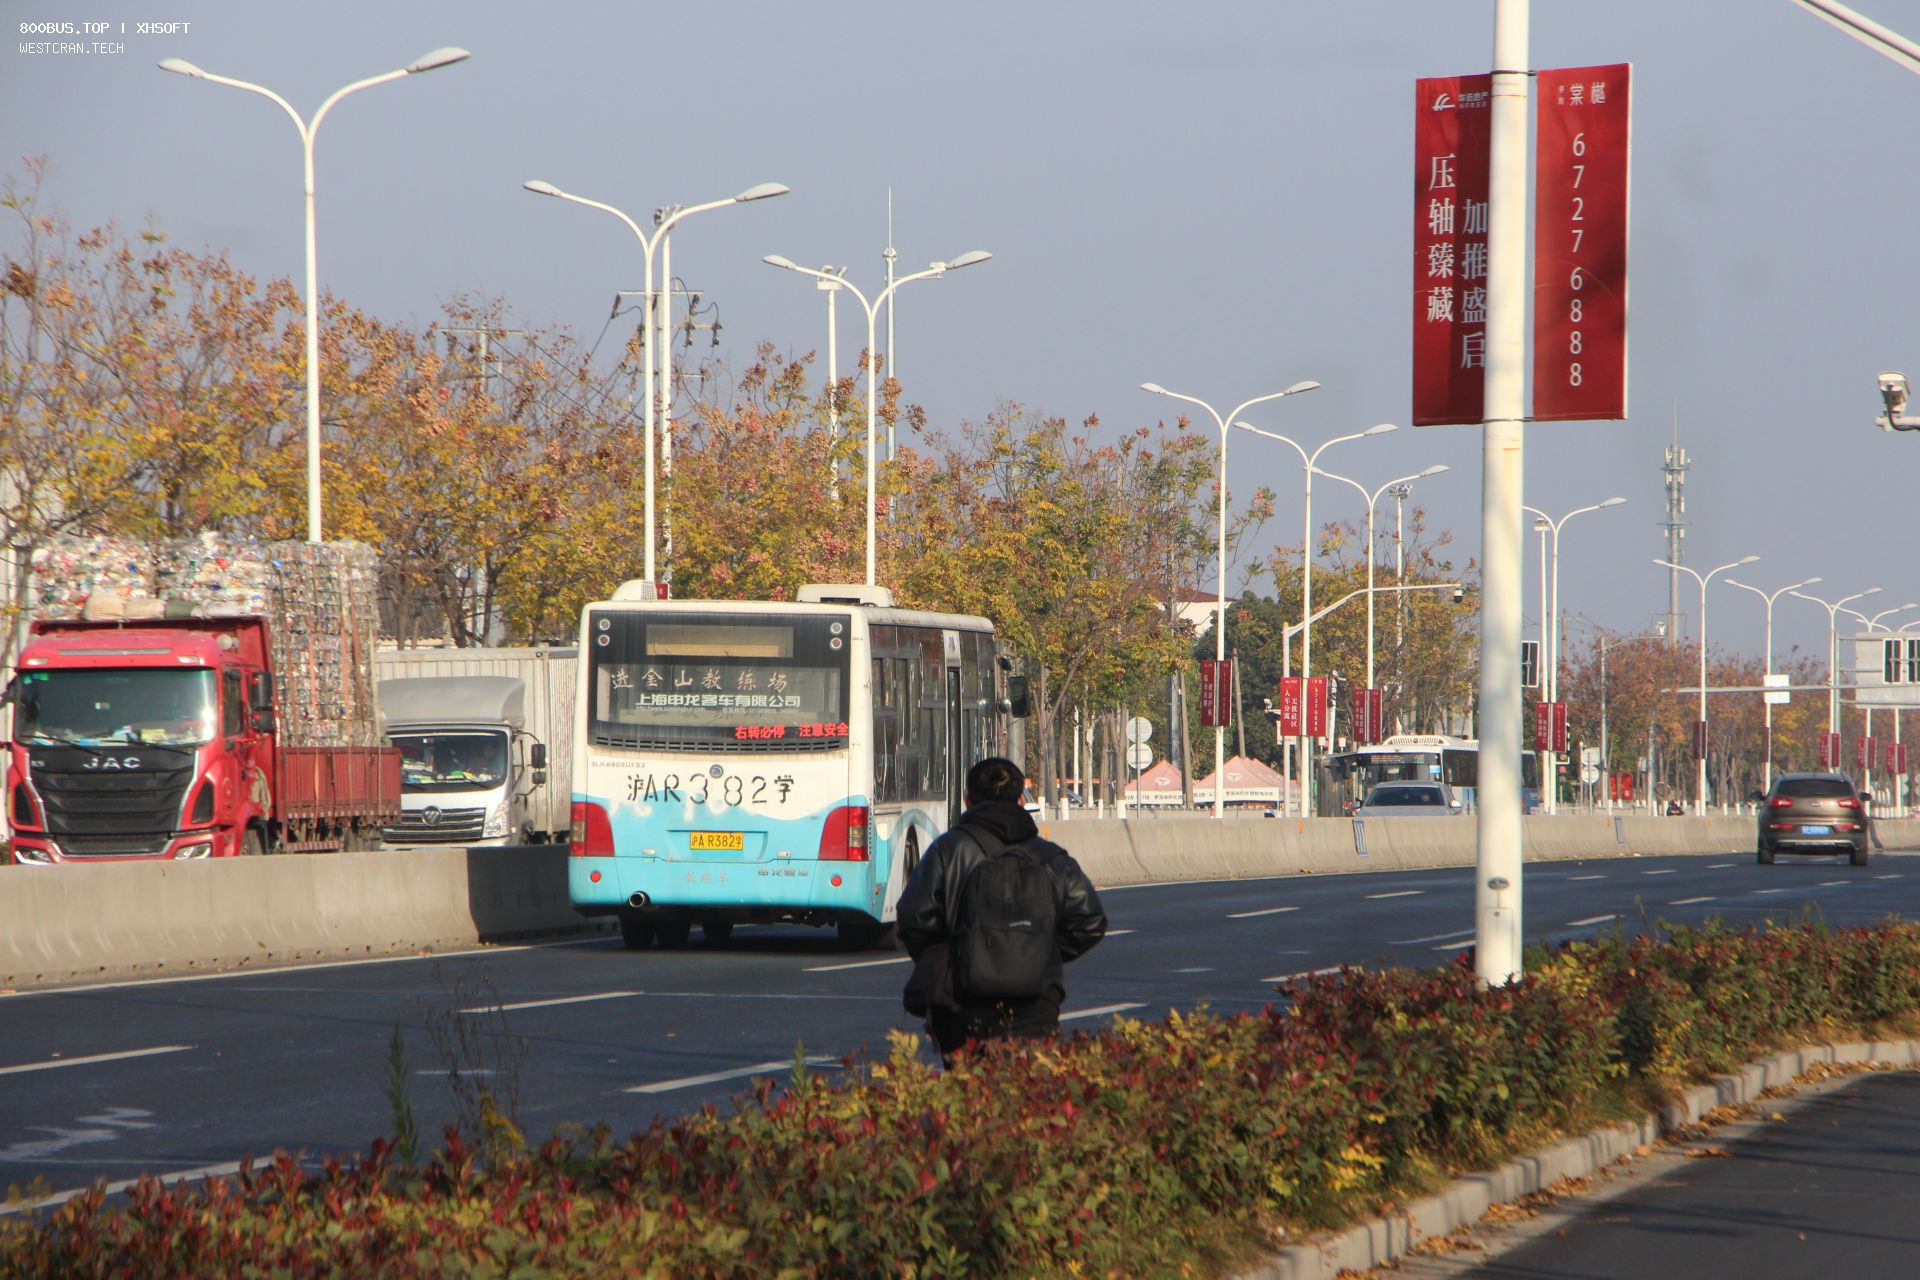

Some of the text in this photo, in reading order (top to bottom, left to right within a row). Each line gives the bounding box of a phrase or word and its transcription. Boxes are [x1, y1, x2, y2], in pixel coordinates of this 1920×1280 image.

[1426, 152, 1456, 324] 压轴臻藏
[1460, 197, 1488, 369] 加推盛启
[635, 693, 801, 708] 上海申龙客车有限公司
[734, 722, 849, 740] 右转必停 注意安全
[83, 756, 141, 769] JAC
[627, 773, 795, 806] 沪AR382学
